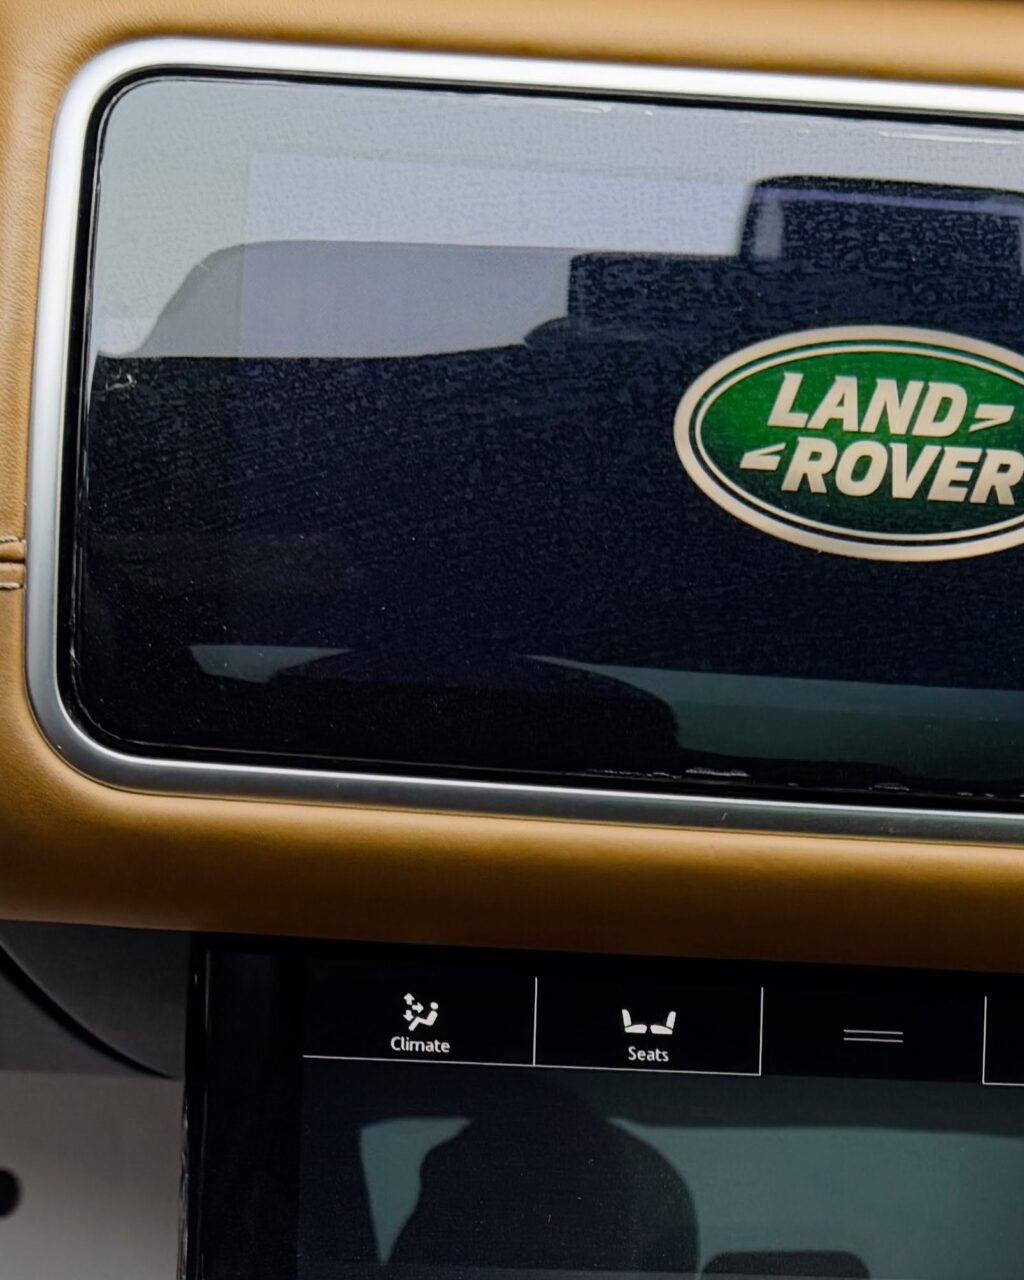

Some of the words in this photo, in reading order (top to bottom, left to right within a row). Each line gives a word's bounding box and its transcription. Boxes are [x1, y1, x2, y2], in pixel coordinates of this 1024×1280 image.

[767, 372, 968, 437] LAND
[390, 1036, 451, 1054] Climate
[627, 1045, 670, 1062] Seats
